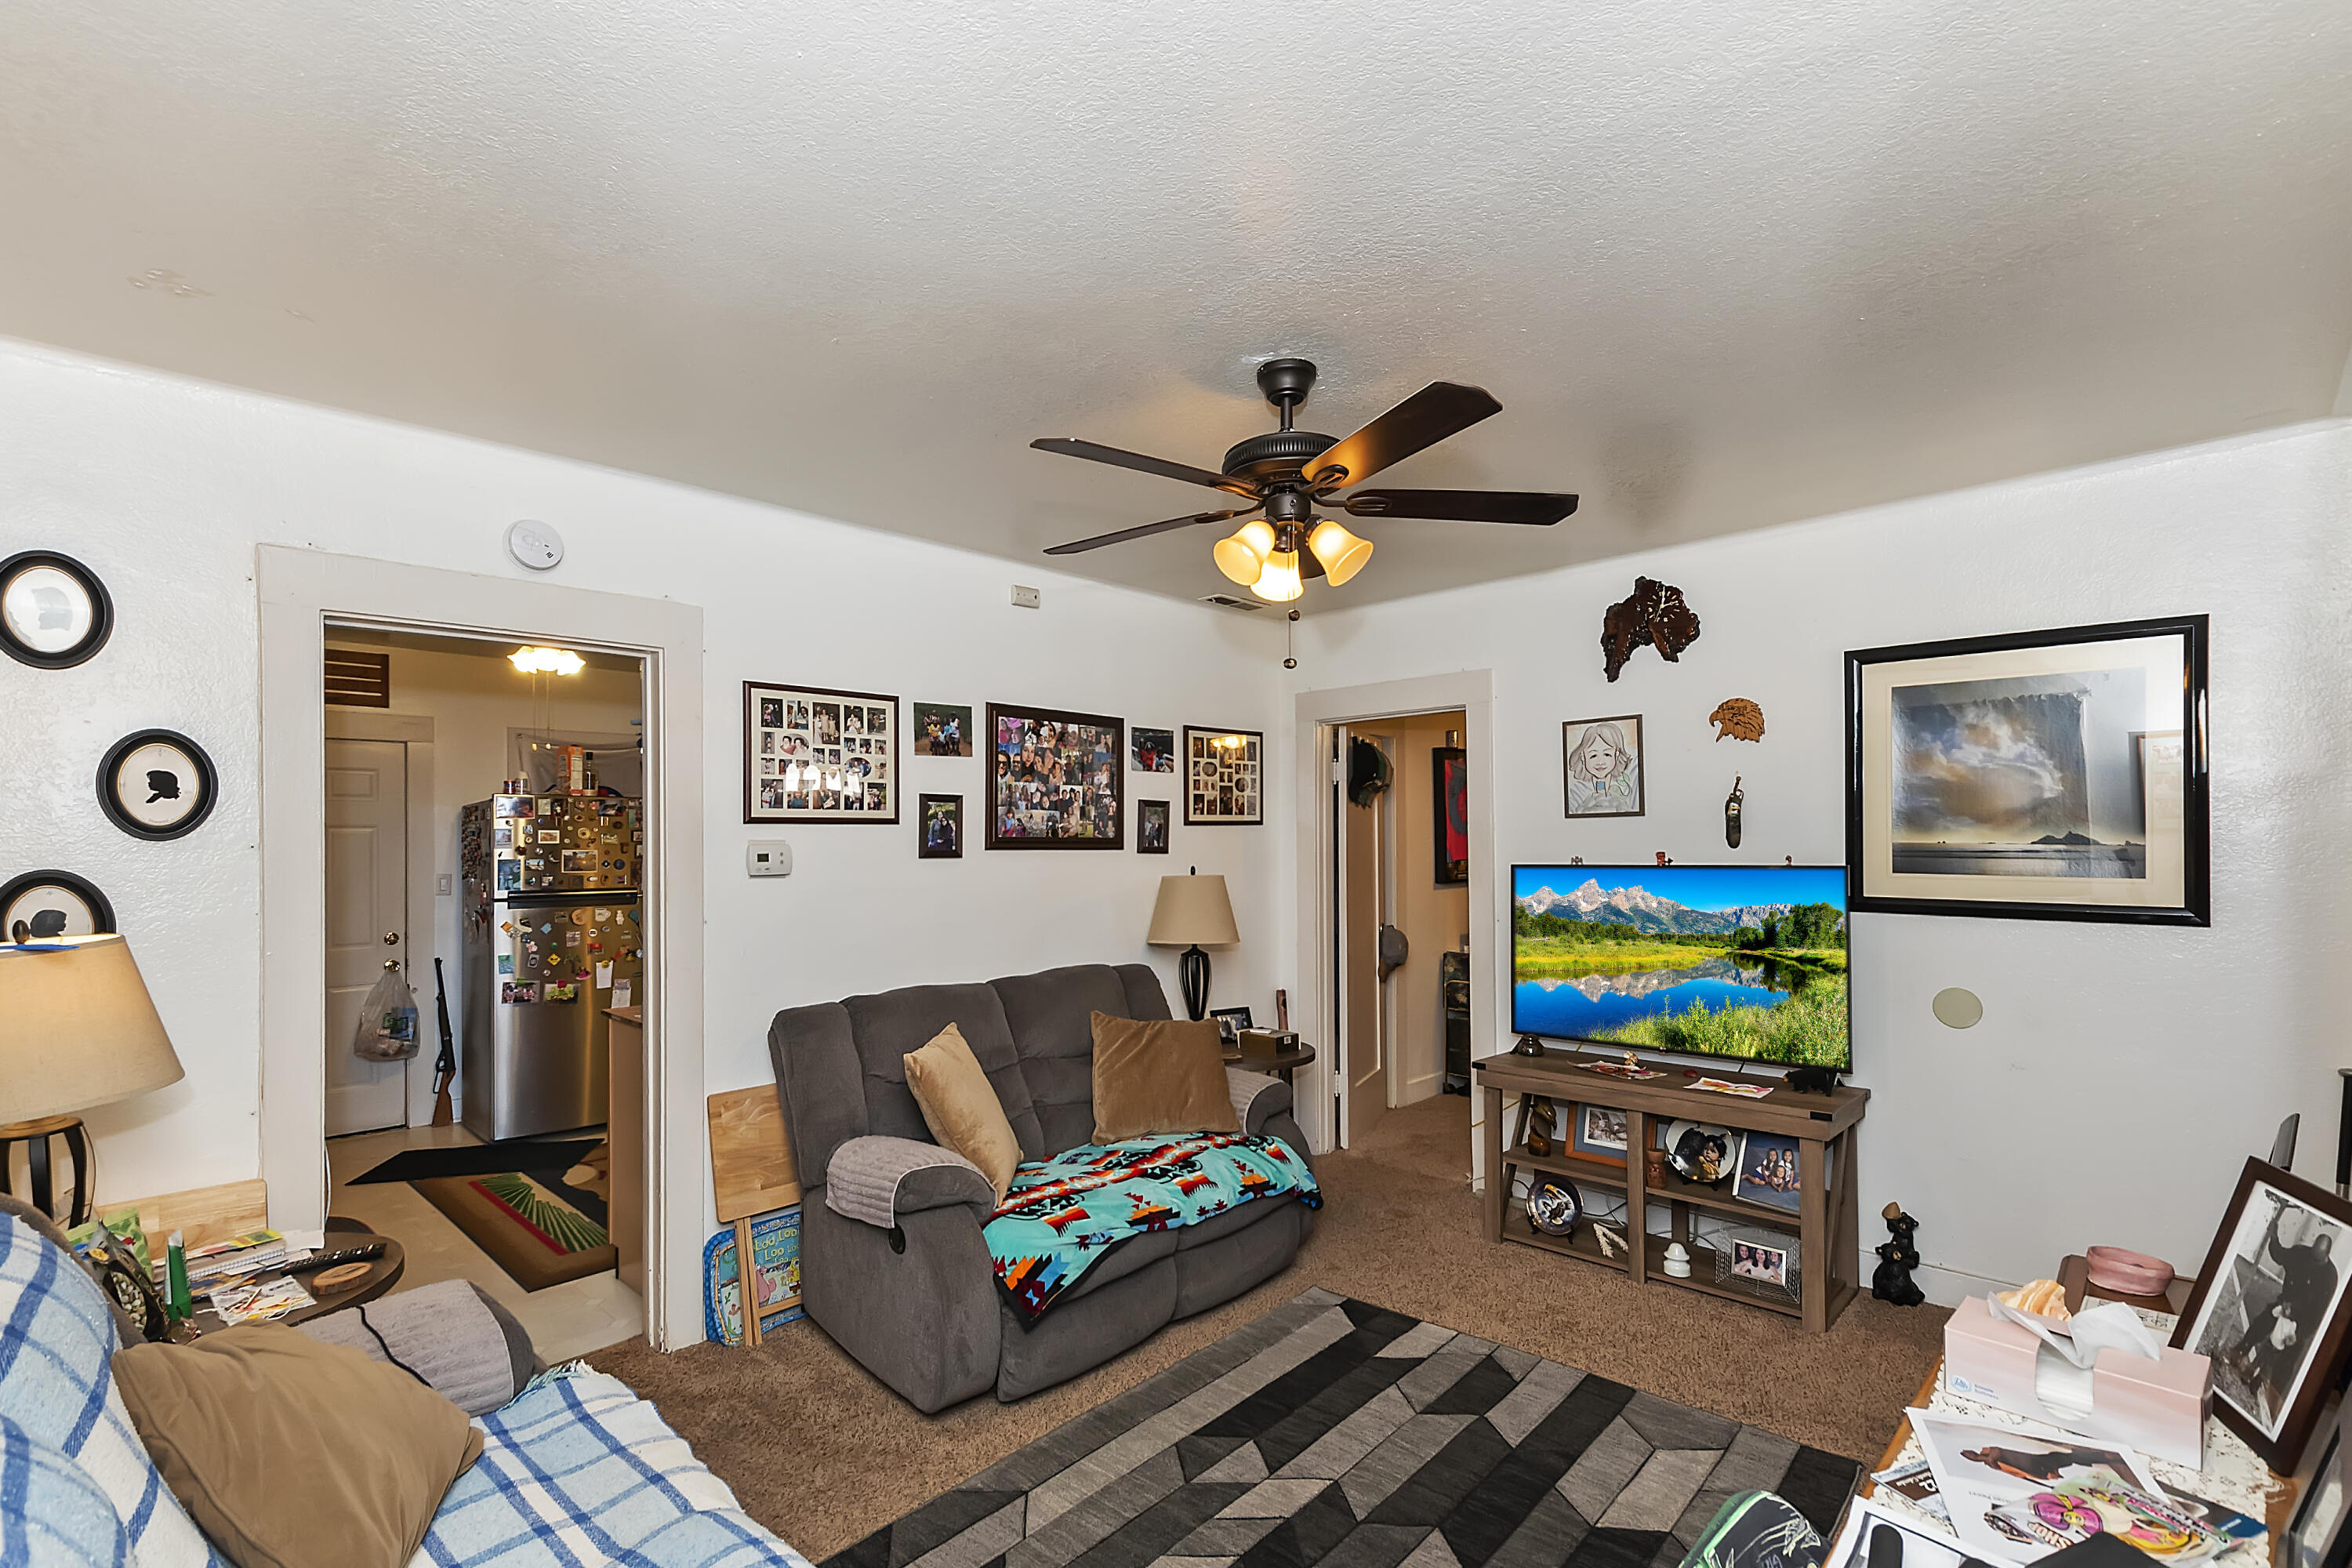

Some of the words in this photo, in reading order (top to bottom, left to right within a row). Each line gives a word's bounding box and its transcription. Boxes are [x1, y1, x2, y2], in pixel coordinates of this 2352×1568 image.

[754, 1236, 775, 1251] Loo
[764, 1247, 784, 1261] Loo
[2027, 1522, 2074, 1549] SHOP
